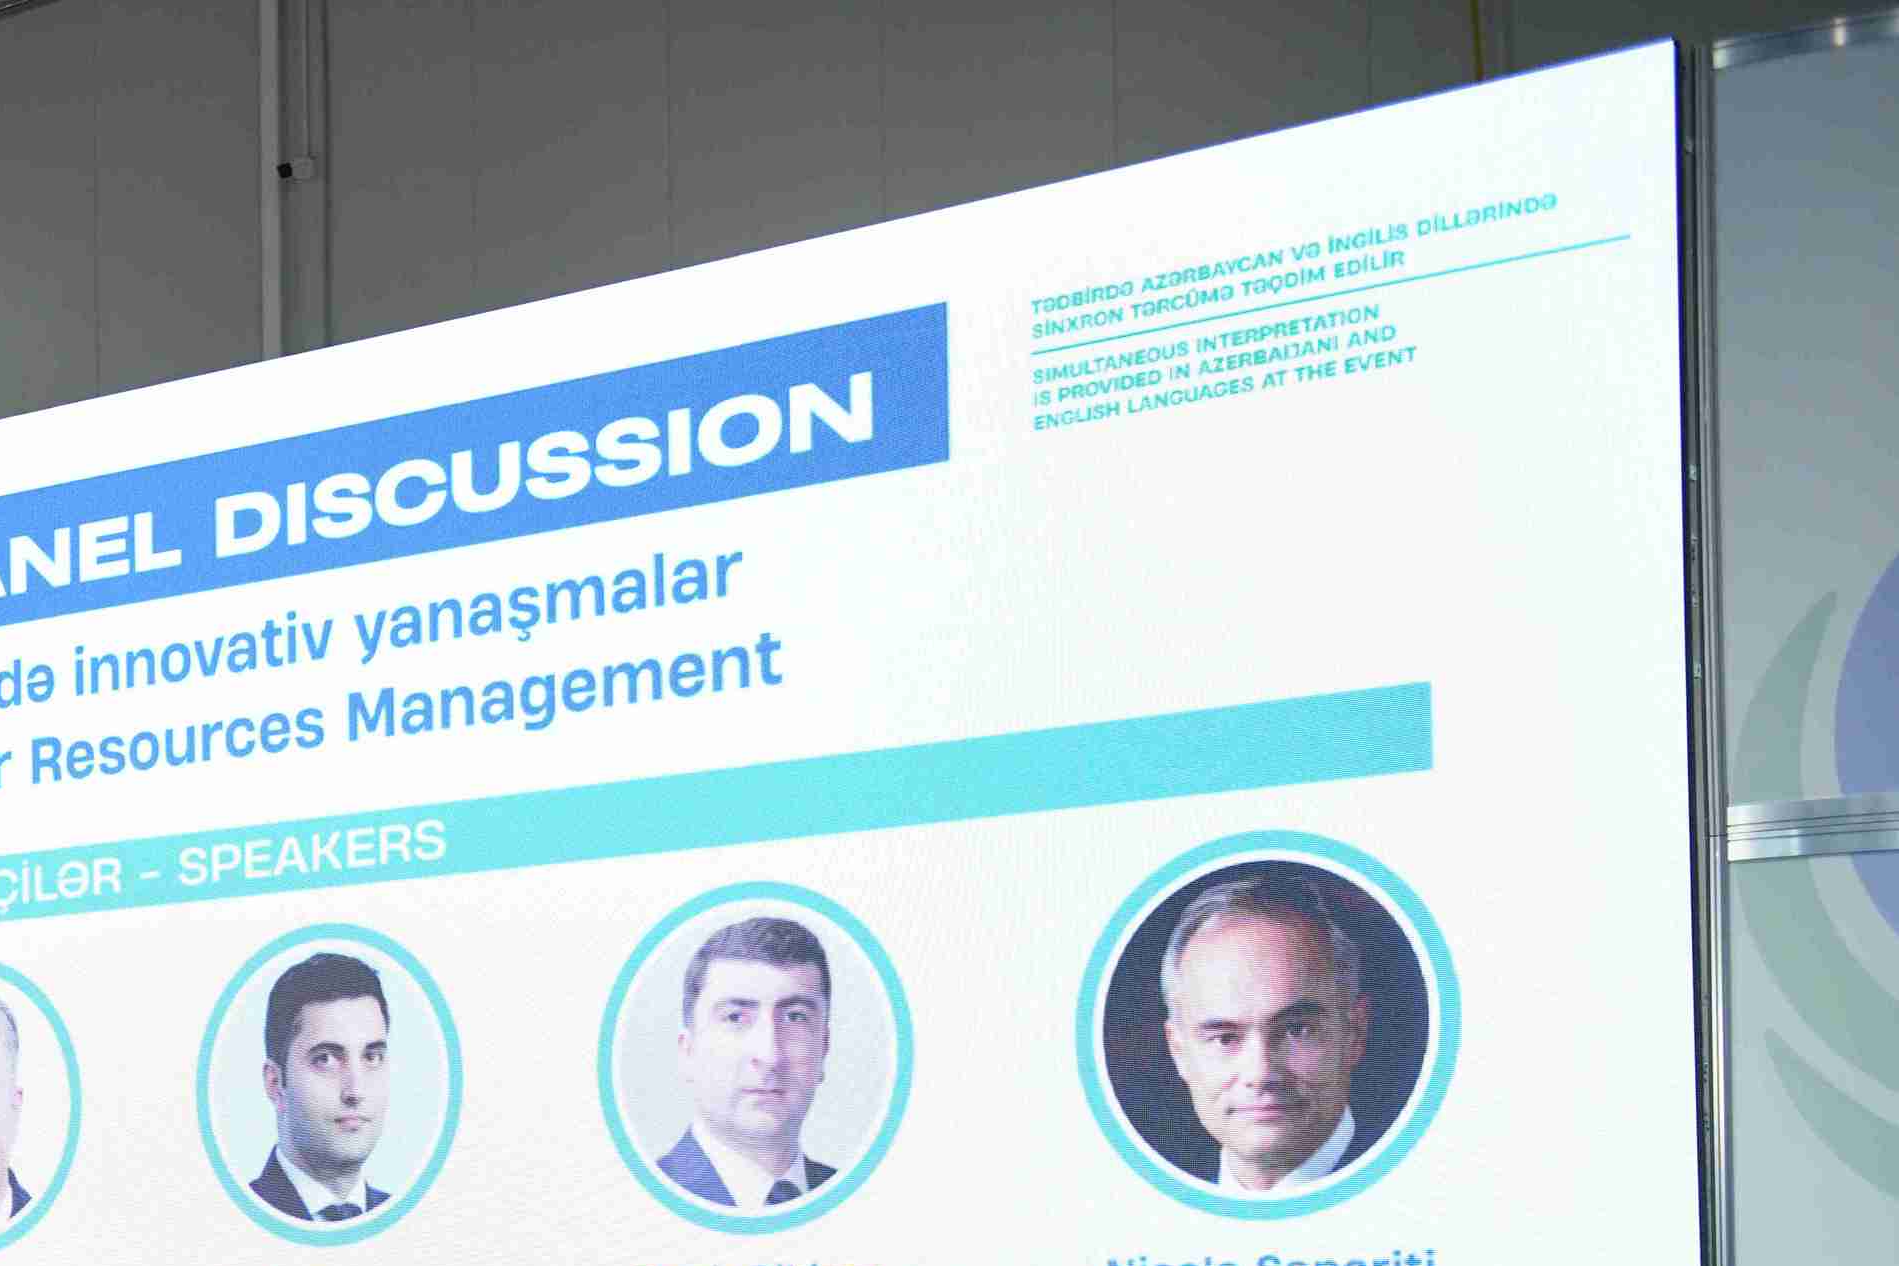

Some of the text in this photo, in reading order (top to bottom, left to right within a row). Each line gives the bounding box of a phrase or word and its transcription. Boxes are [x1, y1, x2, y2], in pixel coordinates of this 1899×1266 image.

[1032, 303, 1380, 384] SIMULTANEOUS INTERPRETATION
[1033, 324, 1397, 406] IS PROVIDED IN AZERBAIJANI AND
[1033, 345, 1416, 431] ENGLISH LANGUAGES AT THE EVENT
[214, 370, 874, 559] DISCUSSION
[74, 610, 334, 698] innovativ
[353, 550, 743, 664] yanaşmalar
[31, 706, 325, 785] Resources
[347, 631, 783, 741] Management
[177, 818, 449, 887] SPEAKERS
